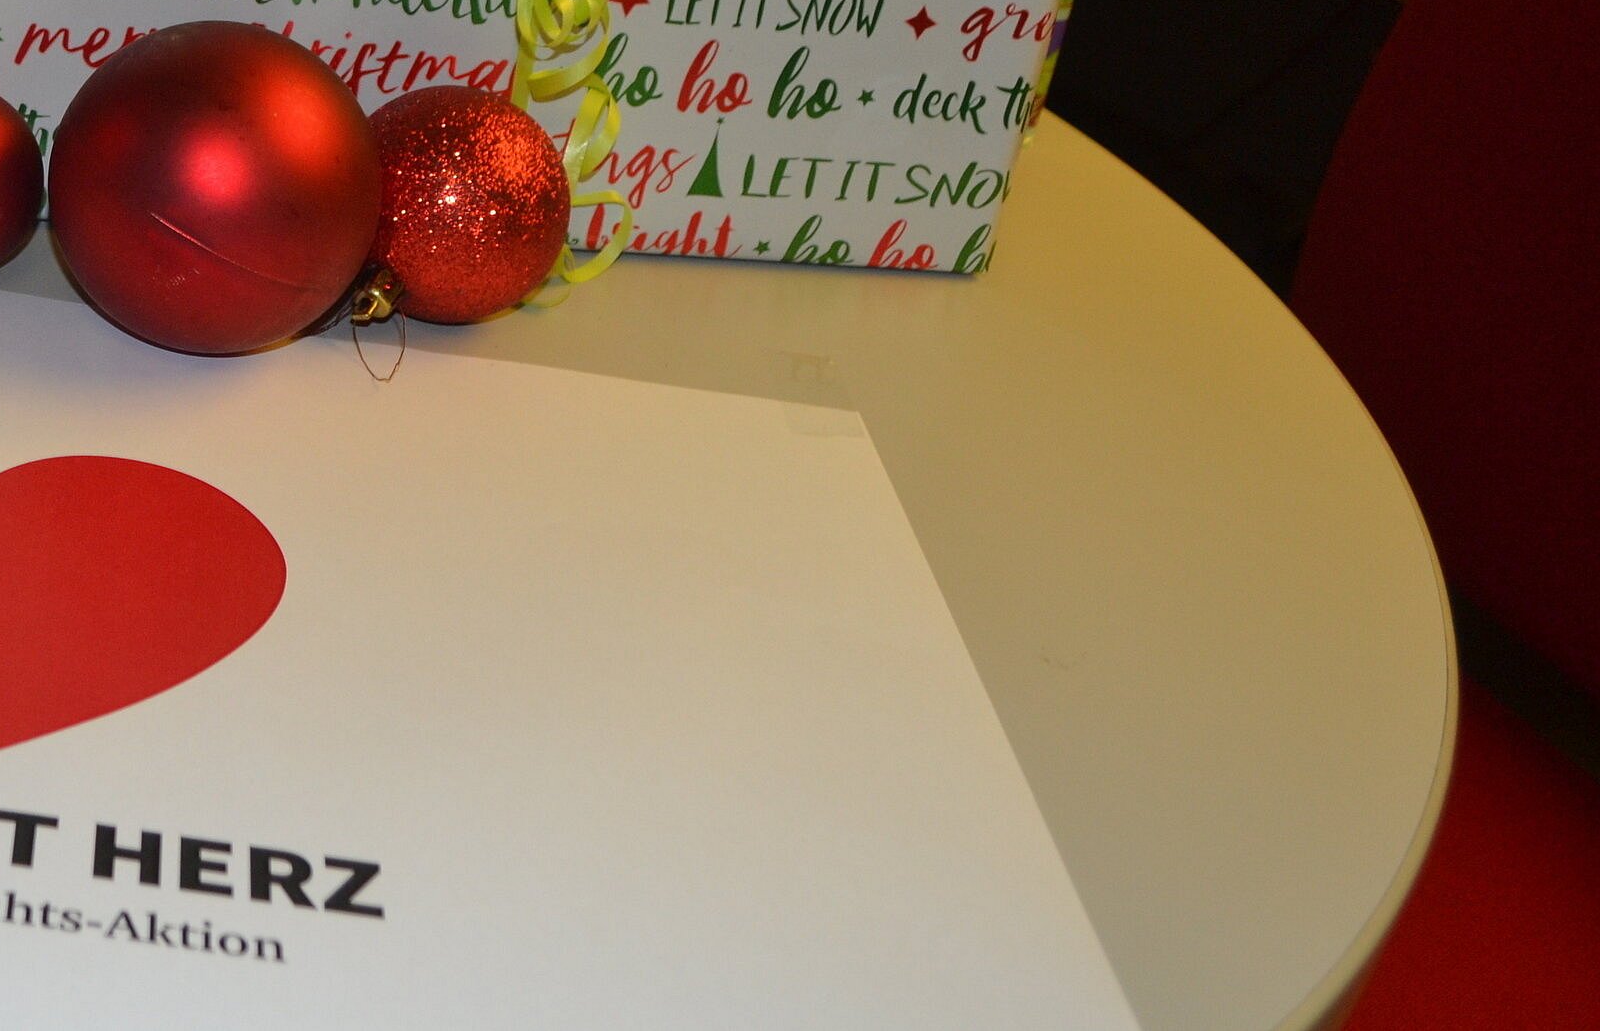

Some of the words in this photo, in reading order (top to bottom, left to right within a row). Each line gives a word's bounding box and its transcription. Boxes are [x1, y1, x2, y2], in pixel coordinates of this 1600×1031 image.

[595, 32, 663, 108] ho
[676, 38, 753, 115] ho
[767, 45, 842, 120] ho
[892, 72, 987, 135] deck
[740, 154, 834, 200] LET
[834, 160, 896, 202] IT
[778, 214, 854, 264] ho
[865, 219, 939, 270] ho
[92, 821, 386, 920] HERZ
